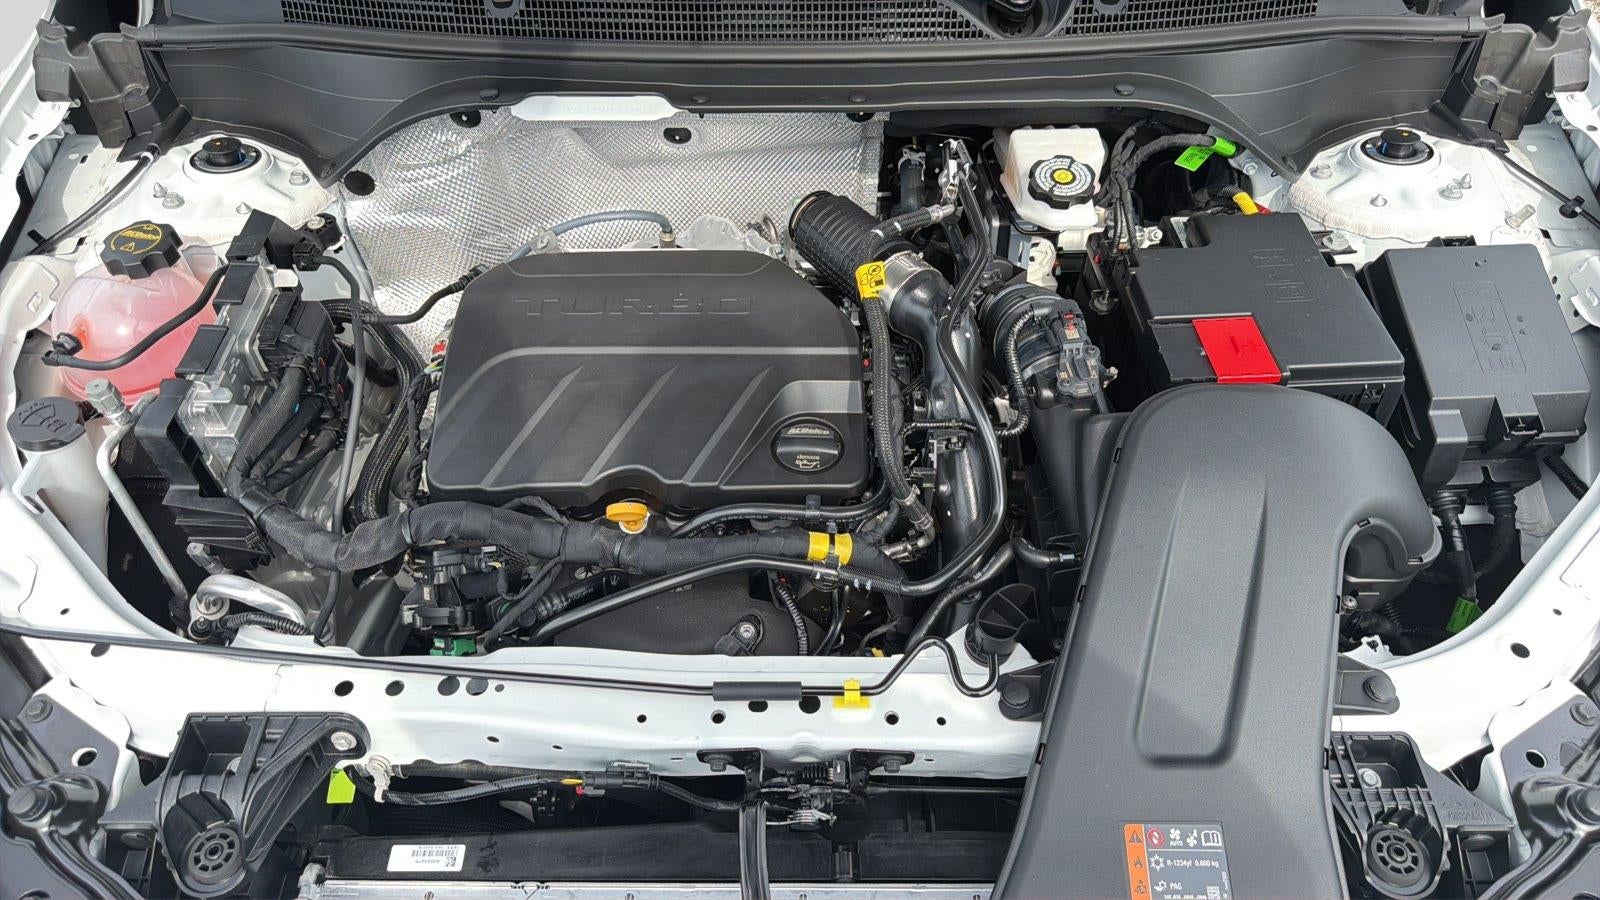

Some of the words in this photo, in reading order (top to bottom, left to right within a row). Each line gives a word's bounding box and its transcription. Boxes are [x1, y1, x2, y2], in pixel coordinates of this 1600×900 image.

[512, 297, 752, 315] TURBO
[1166, 860, 1192, 868] R-1234yf
[1211, 860, 1219, 868] kg
